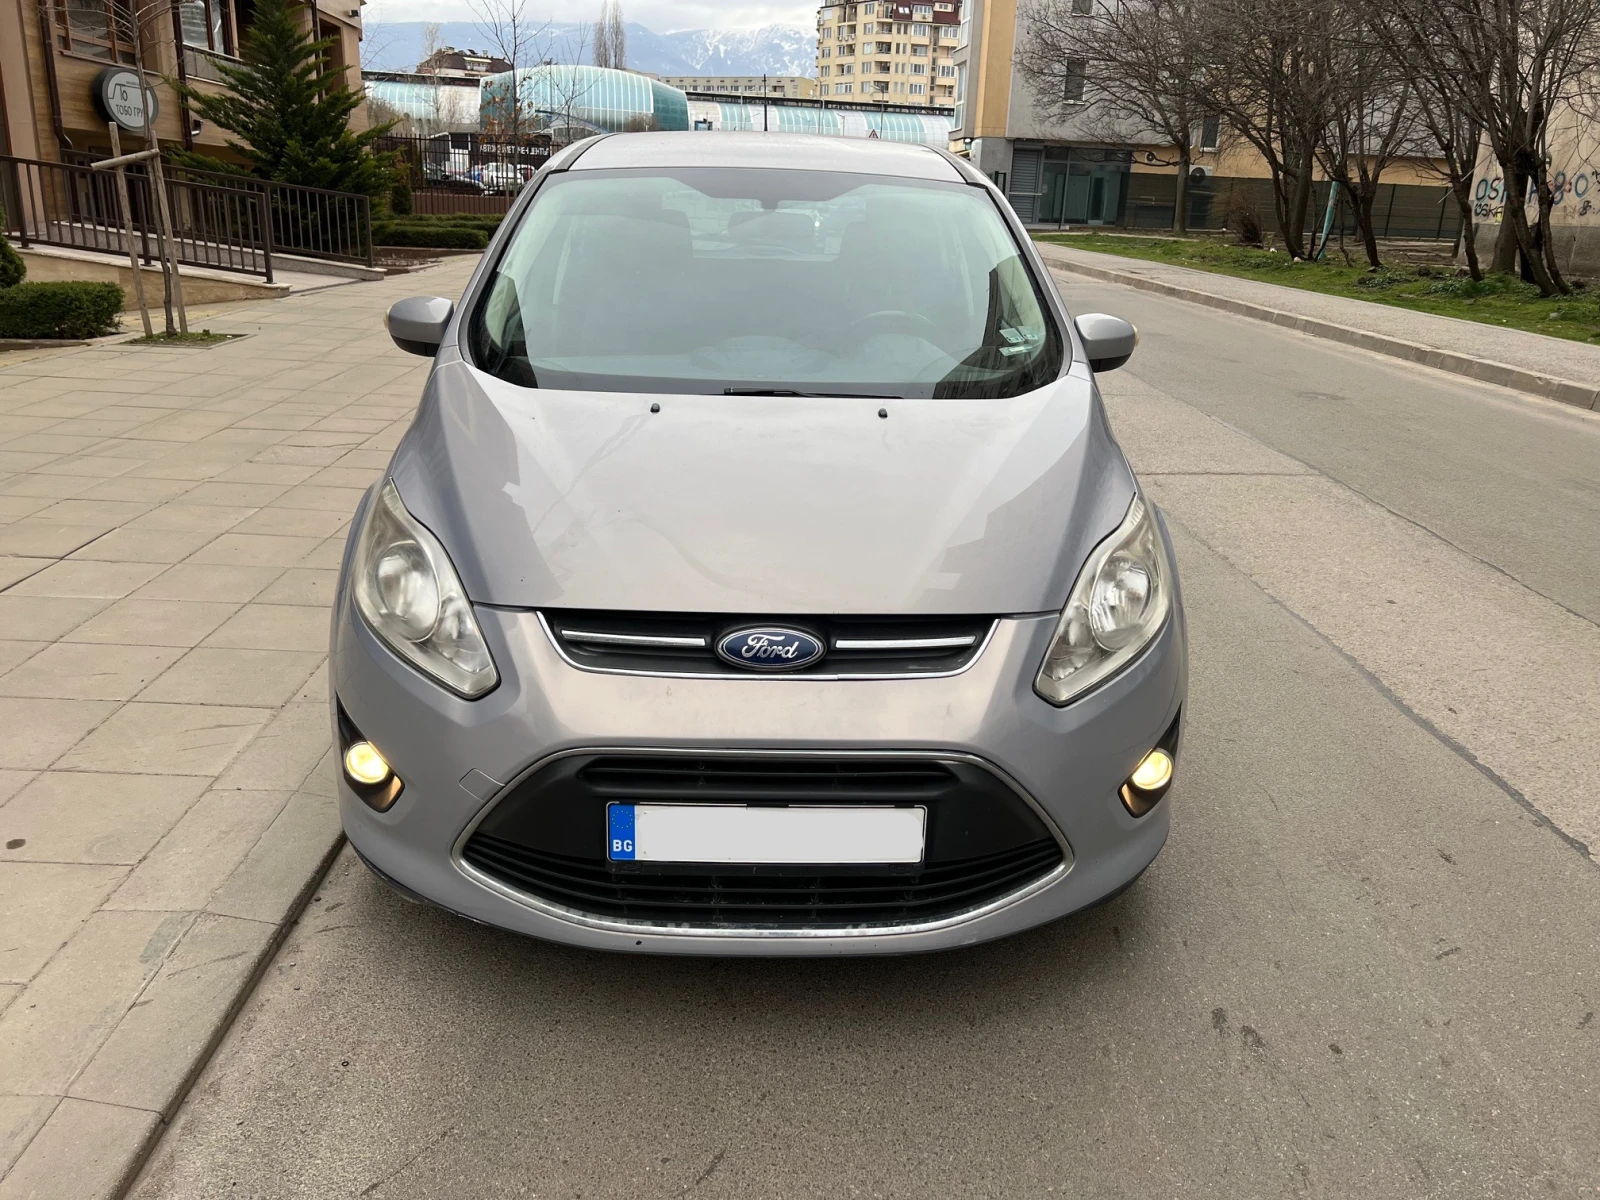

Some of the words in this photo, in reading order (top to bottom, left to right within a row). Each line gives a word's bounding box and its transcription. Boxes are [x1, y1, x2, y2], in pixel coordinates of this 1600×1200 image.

[116, 104, 132, 117] ТОБО
[133, 107, 144, 118] ГРУ
[741, 634, 799, 659] Ford
[612, 839, 633, 852] BG
